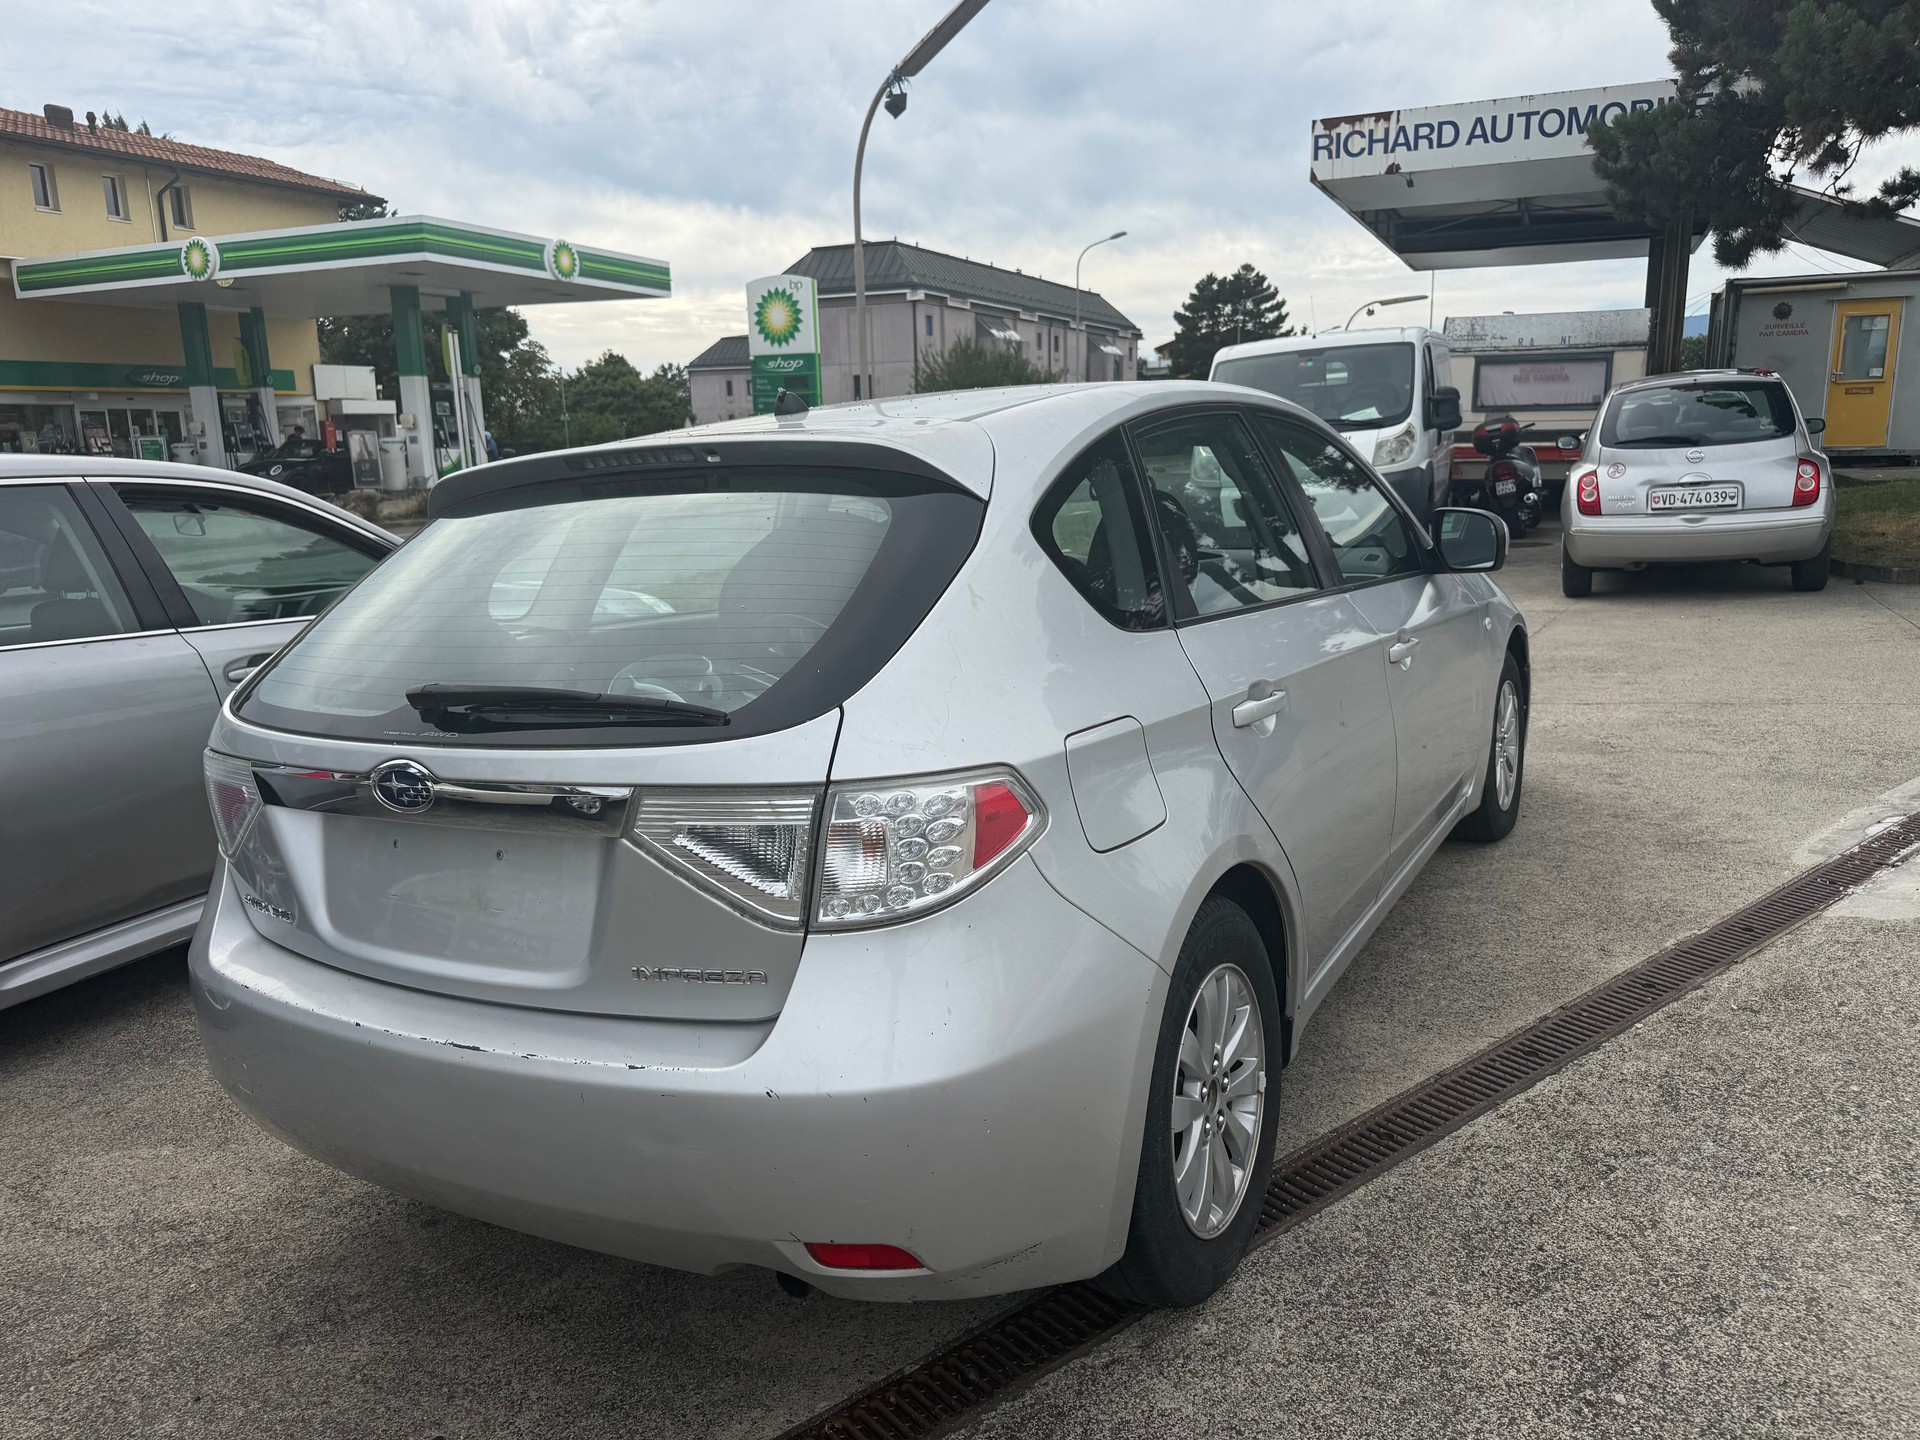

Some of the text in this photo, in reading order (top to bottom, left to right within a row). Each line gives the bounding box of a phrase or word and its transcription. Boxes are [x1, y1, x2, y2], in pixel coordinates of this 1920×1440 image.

[1313, 119, 1460, 161] RICHARD
[788, 279, 803, 292] bp
[766, 357, 804, 371] shop
[142, 371, 179, 385] shop
[631, 965, 768, 985] IMPREZA
